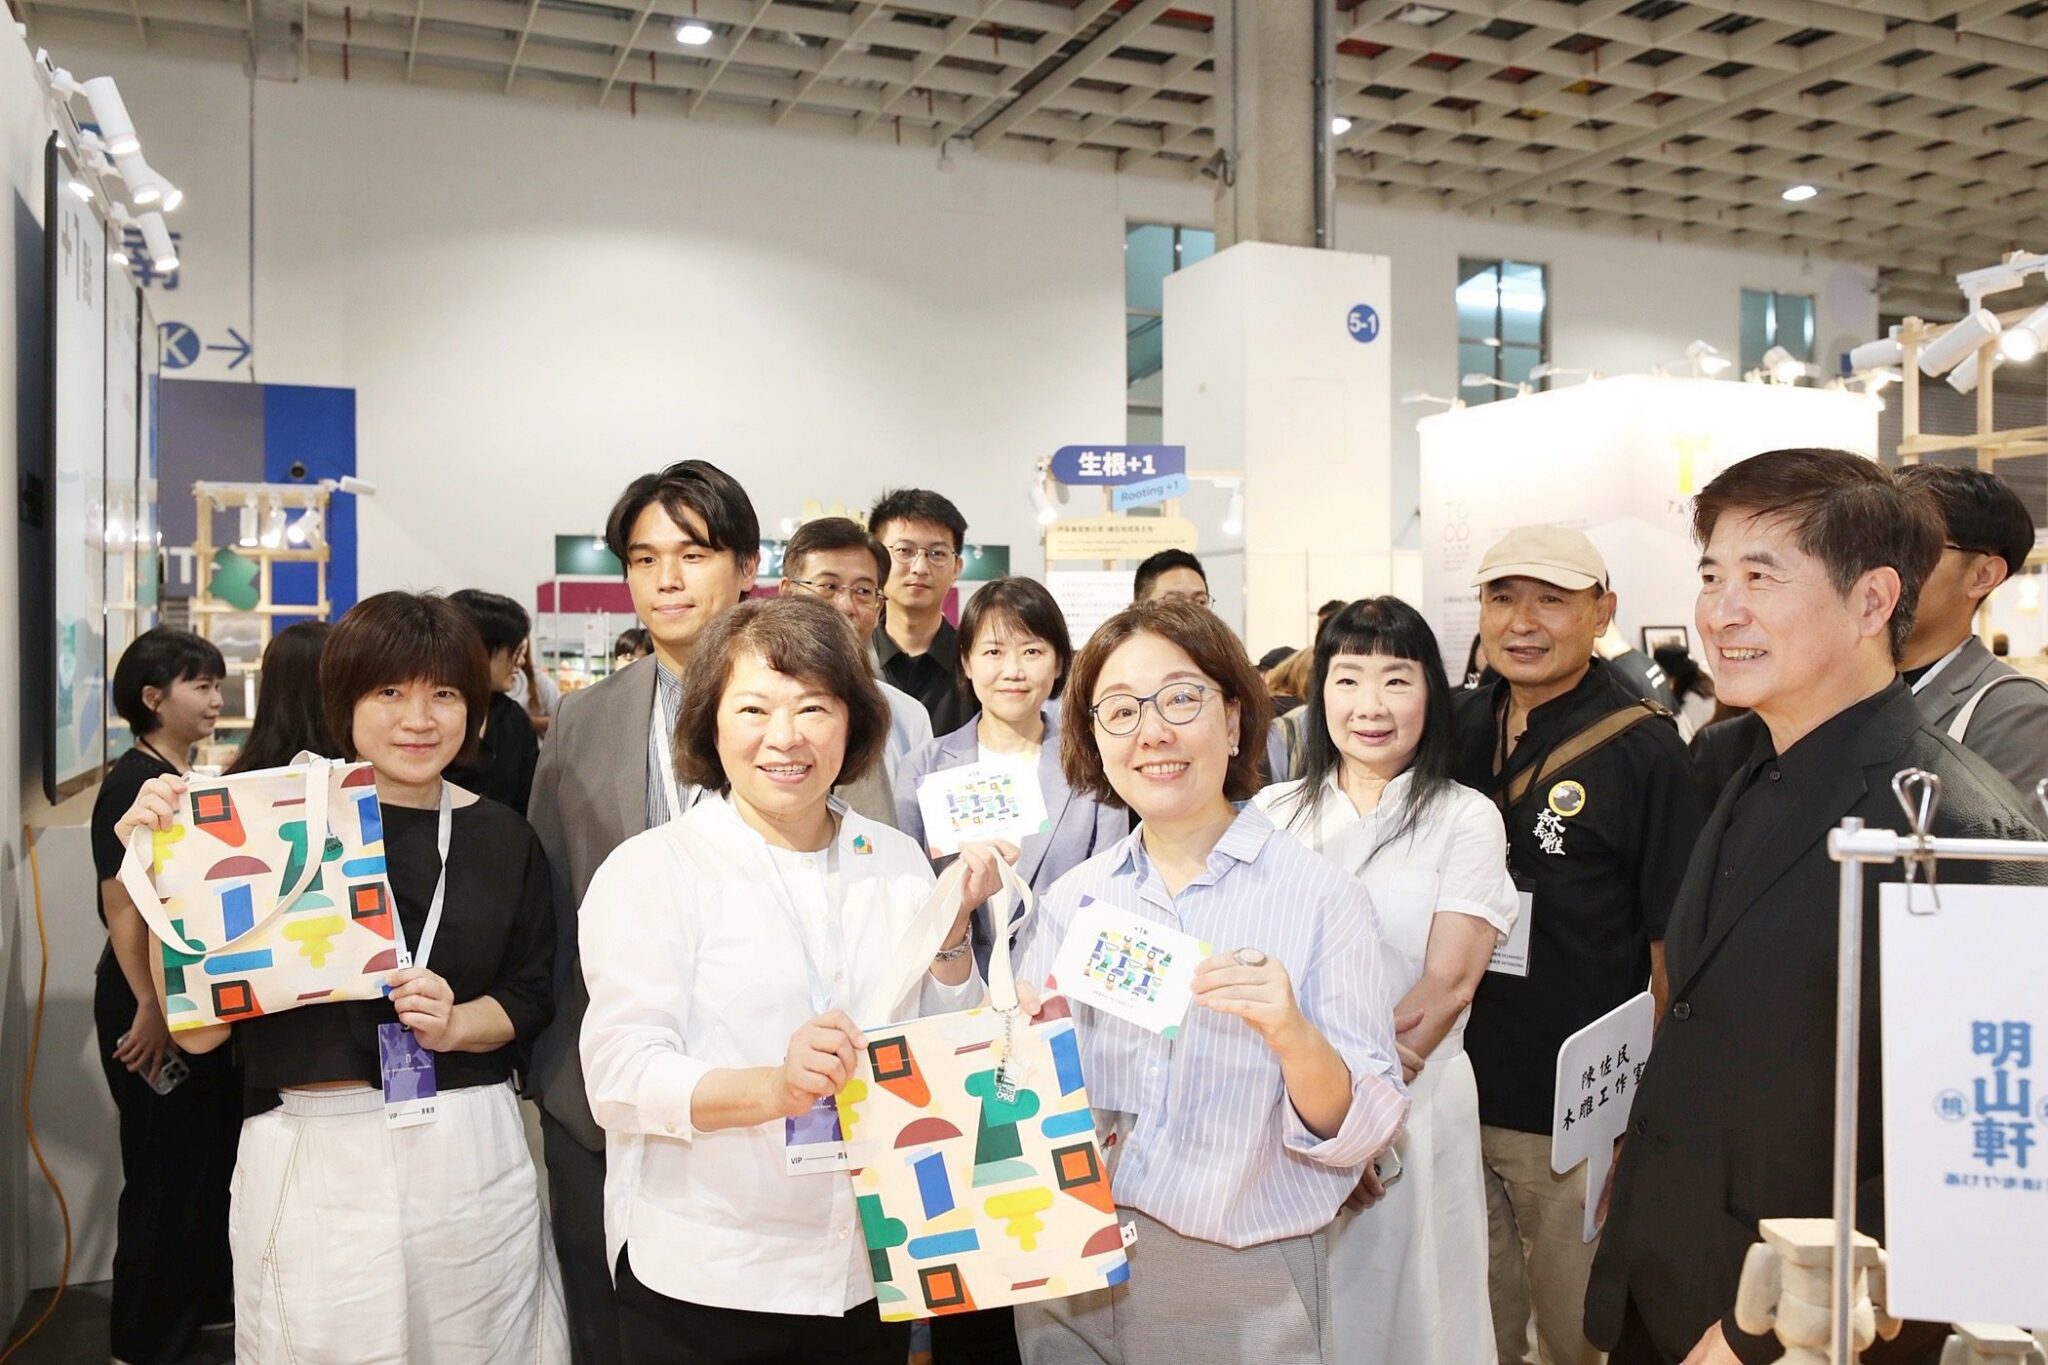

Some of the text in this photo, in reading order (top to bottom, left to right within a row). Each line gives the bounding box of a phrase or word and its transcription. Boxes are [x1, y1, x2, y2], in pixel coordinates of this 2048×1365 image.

[1349, 311, 1377, 335] 5-1
[159, 325, 191, 366] K
[1078, 451, 1156, 477] 生根+1
[1120, 484, 1165, 503] Rooting
[1581, 1043, 1631, 1091] 陳佐民
[1972, 1021, 2035, 1168] 明山軒
[790, 1156, 803, 1165] VIP
